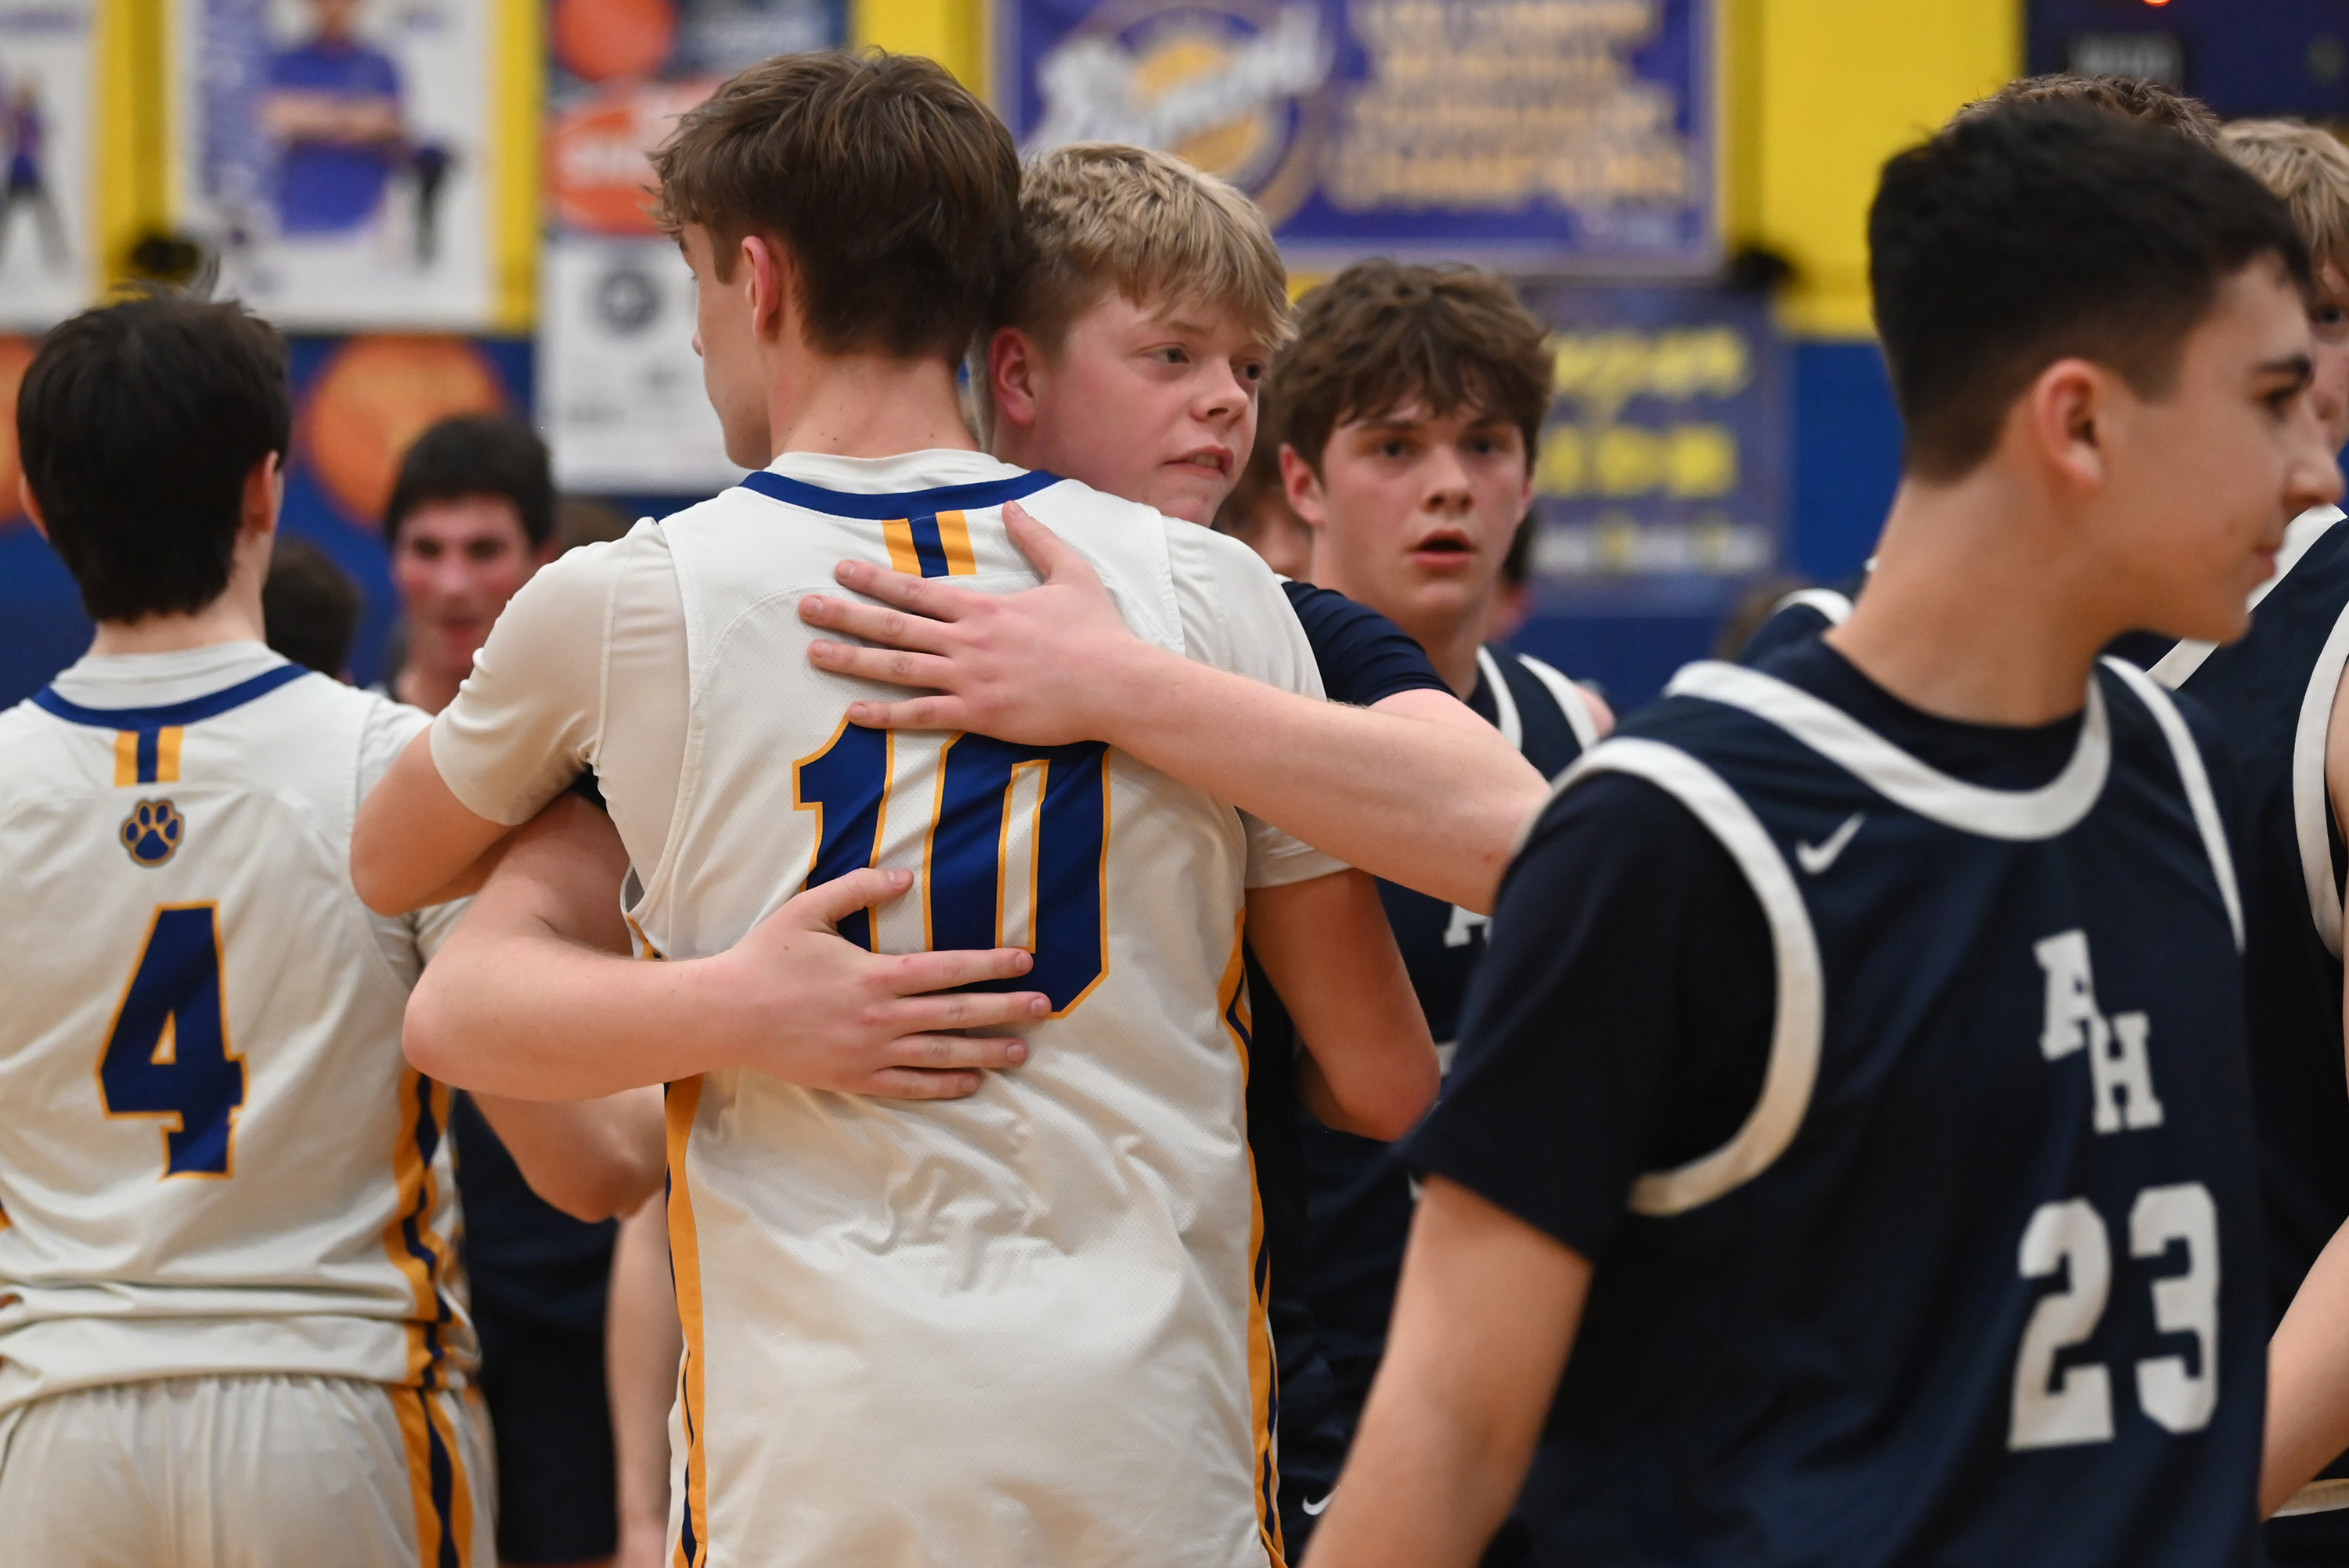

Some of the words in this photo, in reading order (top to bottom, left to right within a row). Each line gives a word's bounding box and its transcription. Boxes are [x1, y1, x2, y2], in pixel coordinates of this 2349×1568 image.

[792, 713, 1110, 1019] 10
[94, 900, 249, 1181] 4
[2006, 1181, 2220, 1451] 23
